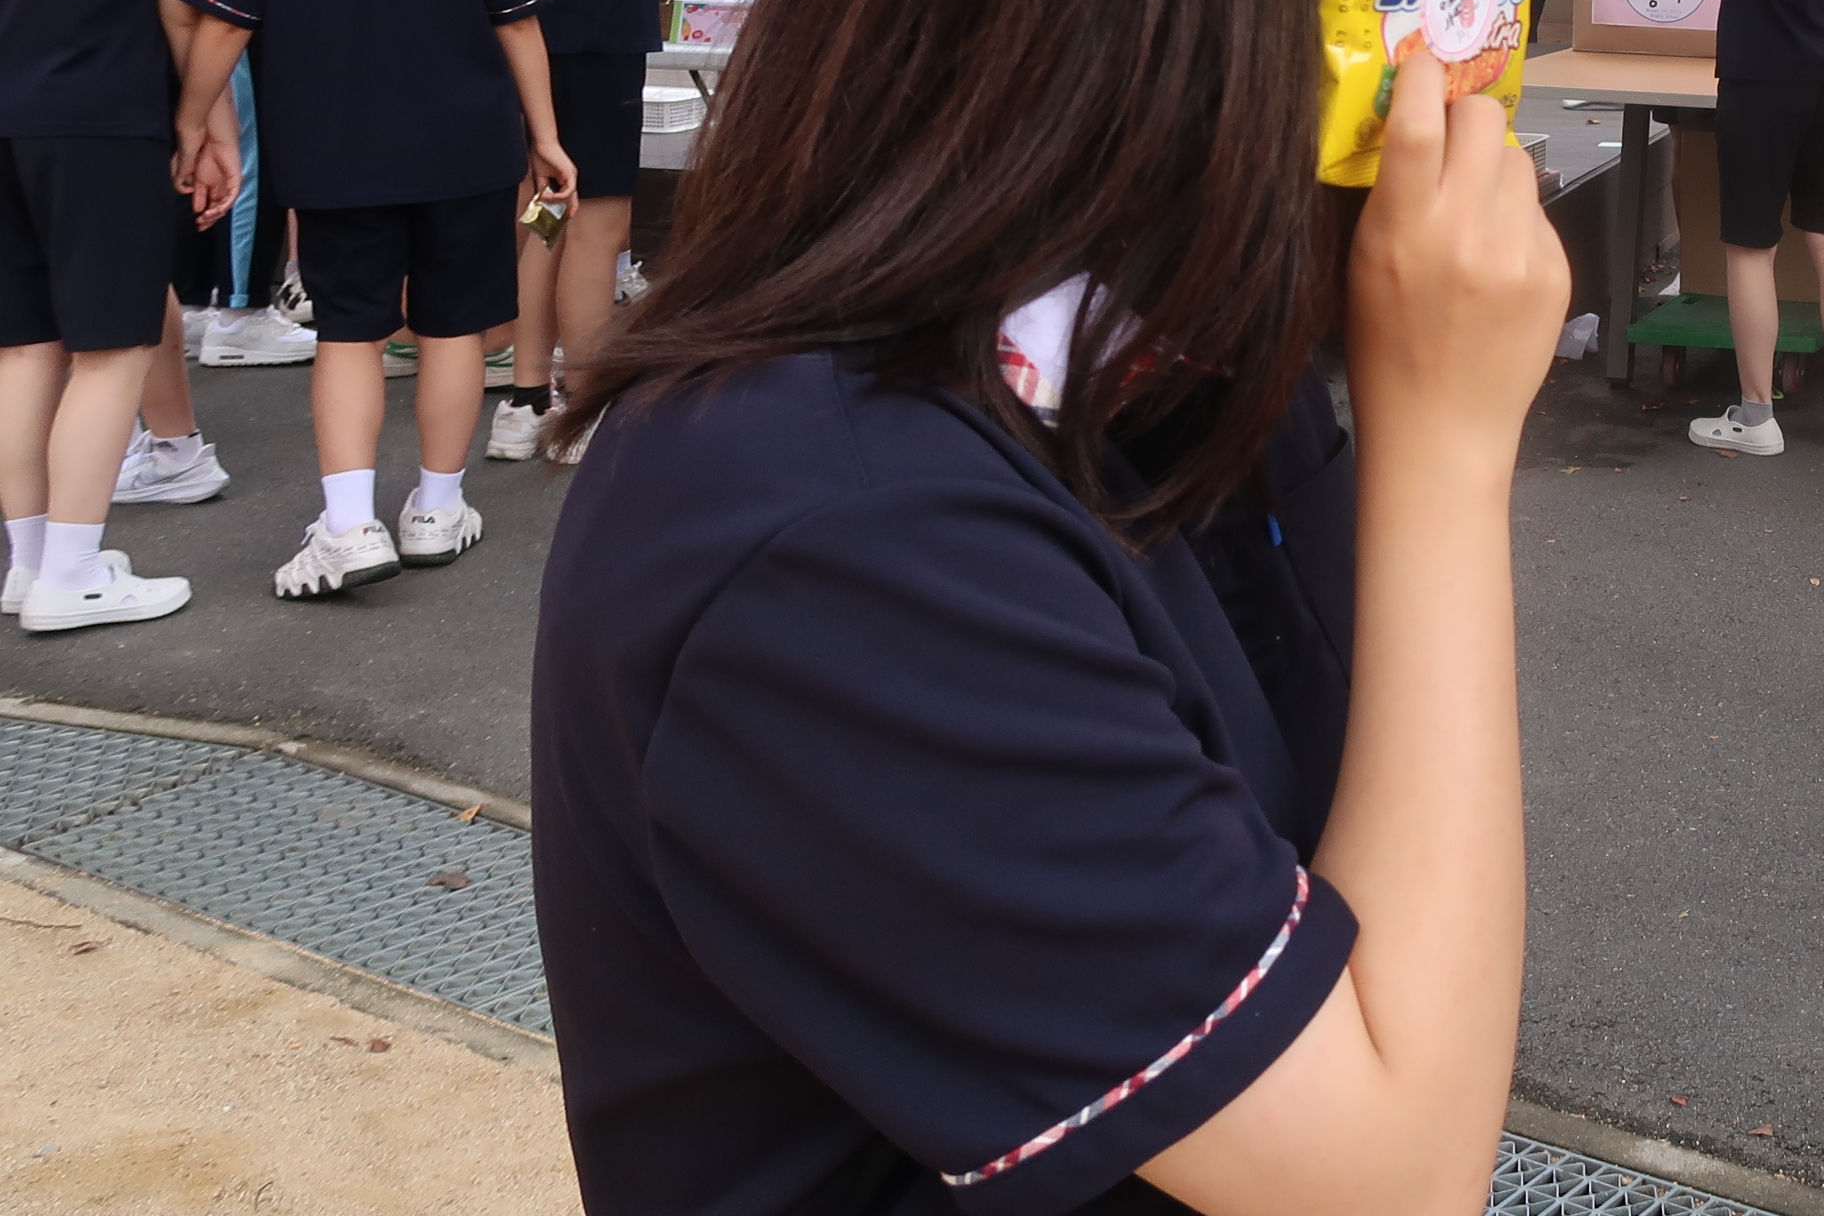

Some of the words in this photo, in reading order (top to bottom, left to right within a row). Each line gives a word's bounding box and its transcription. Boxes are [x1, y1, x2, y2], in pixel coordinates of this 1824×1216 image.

[1485, 10, 1522, 50] tra
[412, 515, 436, 524] FILA
[362, 525, 386, 535] FILA
